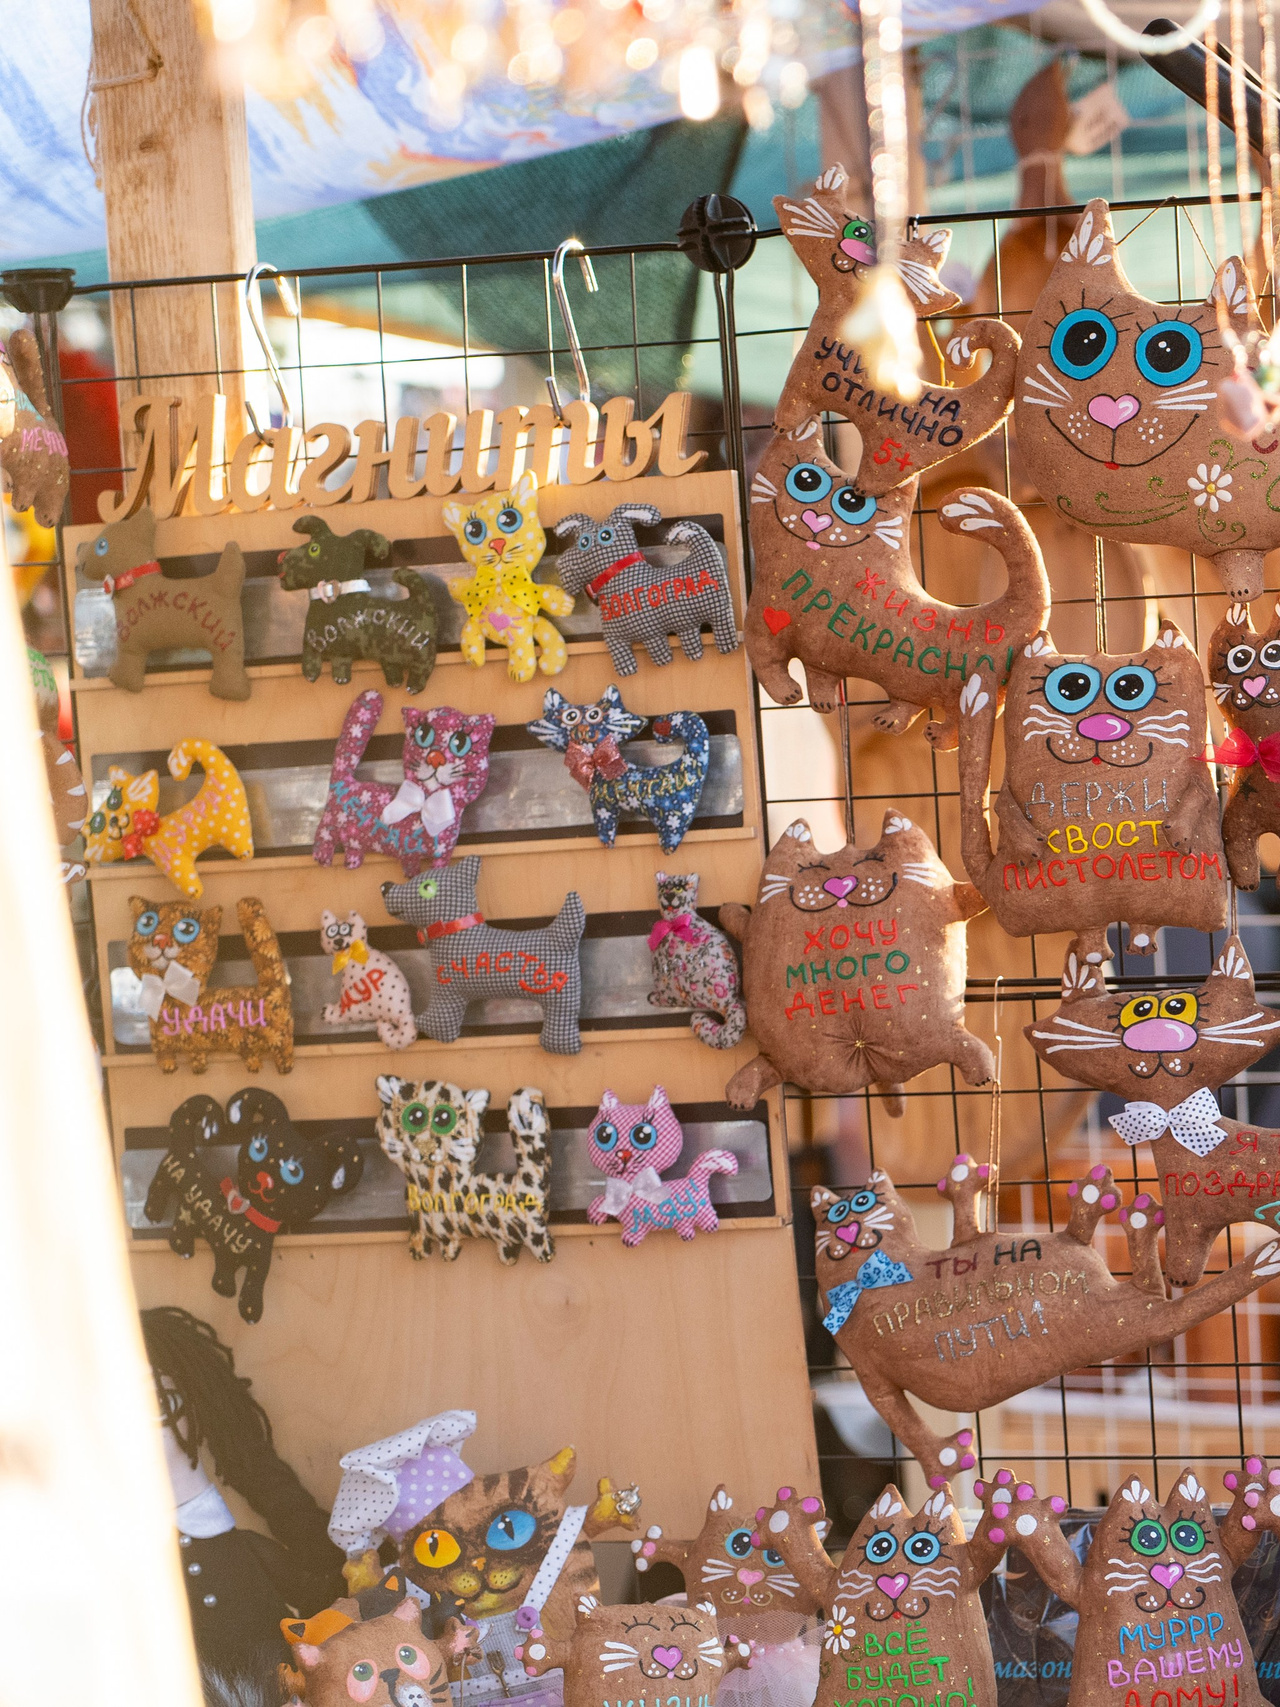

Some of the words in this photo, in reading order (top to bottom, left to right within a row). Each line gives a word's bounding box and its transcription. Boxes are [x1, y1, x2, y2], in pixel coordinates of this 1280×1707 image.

[821, 371, 964, 448] ОТЛИЧНО
[918, 391, 962, 423] НА
[98, 391, 708, 526] Магниты
[873, 437, 913, 472] 5+
[599, 569, 719, 622] ВОЛГОГРАД
[855, 567, 1006, 644] ЖИЗНЬ
[1024, 777, 1169, 820] ДЕРЖИ
[1002, 850, 1223, 892] ПИСТОЛЕТОМ
[803, 918, 899, 955] ХОЧУ
[436, 950, 569, 994] СЧАСТЬЯ
[785, 949, 911, 989] МНОГО
[162, 998, 267, 1036] УДАЧИ
[784, 983, 919, 1021] ДЕНЕГ
[1229, 1130, 1259, 1156] Я
[163, 1154, 186, 1184] НА
[184, 1183, 253, 1254] УДАЧУ
[630, 1178, 707, 1234] МЯУ!
[925, 1251, 979, 1280] ТЫ
[993, 1238, 1043, 1266] НА
[872, 1269, 1090, 1338] ПРАВИЛЬНОМ
[933, 1299, 1050, 1362] ПУТИ!
[864, 1620, 930, 1657] ВСЁ
[1118, 1612, 1225, 1655] МУРРР
[846, 1655, 951, 1691] БУДЕТ
[1106, 1638, 1245, 1688] ВАШЕМУ
